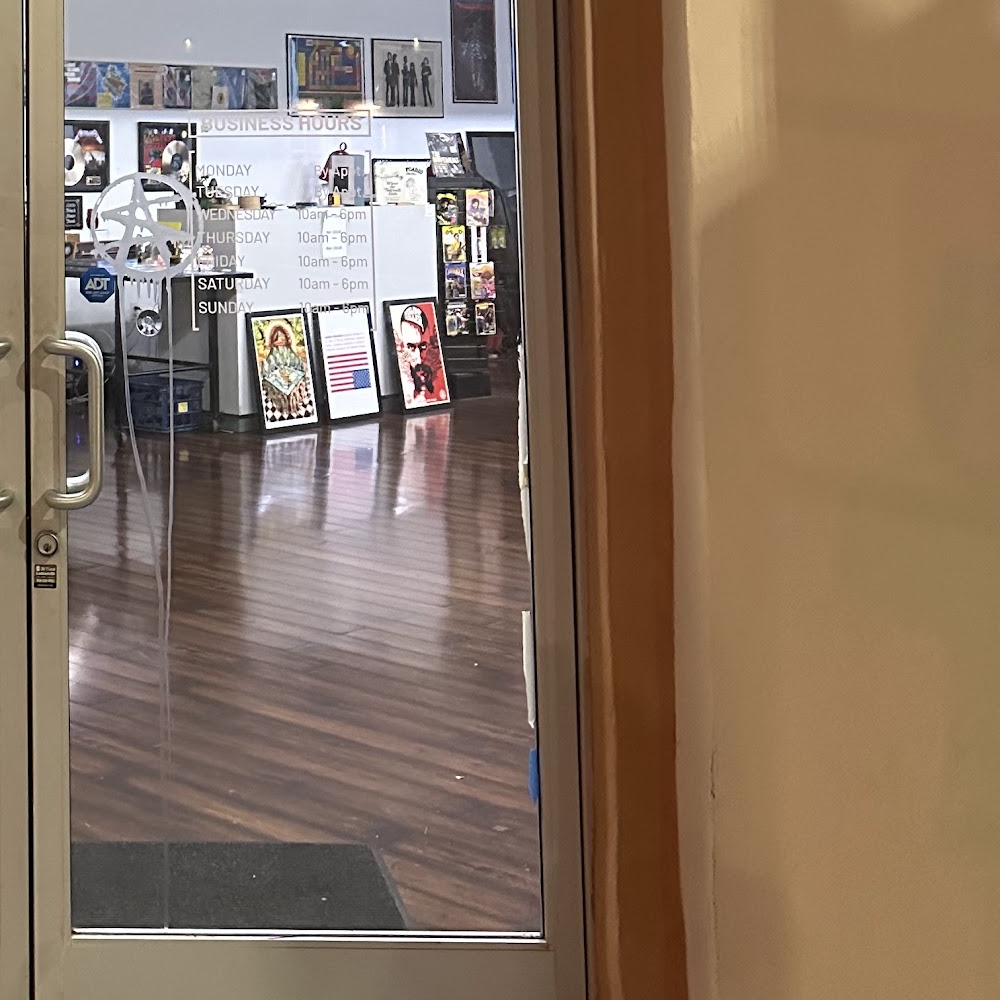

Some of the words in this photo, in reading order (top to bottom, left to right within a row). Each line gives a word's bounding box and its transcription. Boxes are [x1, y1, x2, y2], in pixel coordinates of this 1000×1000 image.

[201, 116, 294, 132] BUSINESS
[299, 116, 362, 132] HOURS
[197, 164, 252, 177] MONDAY
[196, 185, 259, 199] TUESDAY
[200, 207, 275, 221] WEDNESDAY
[298, 208, 329, 221] 10am
[340, 208, 367, 223] 6pm
[197, 231, 271, 244] THURSDAY
[298, 231, 329, 244] 10am
[340, 231, 367, 246] 6pm
[198, 254, 246, 269] IDAY
[298, 255, 330, 268] 10am
[341, 255, 368, 270] 6pm
[85, 277, 111, 291] ADT
[198, 277, 271, 291] SATURDAY
[298, 277, 330, 290] 10am
[341, 277, 369, 293] 6pm
[198, 300, 255, 315] SUNDAY
[299, 301, 331, 314] 10am
[342, 301, 370, 317] 6pm
